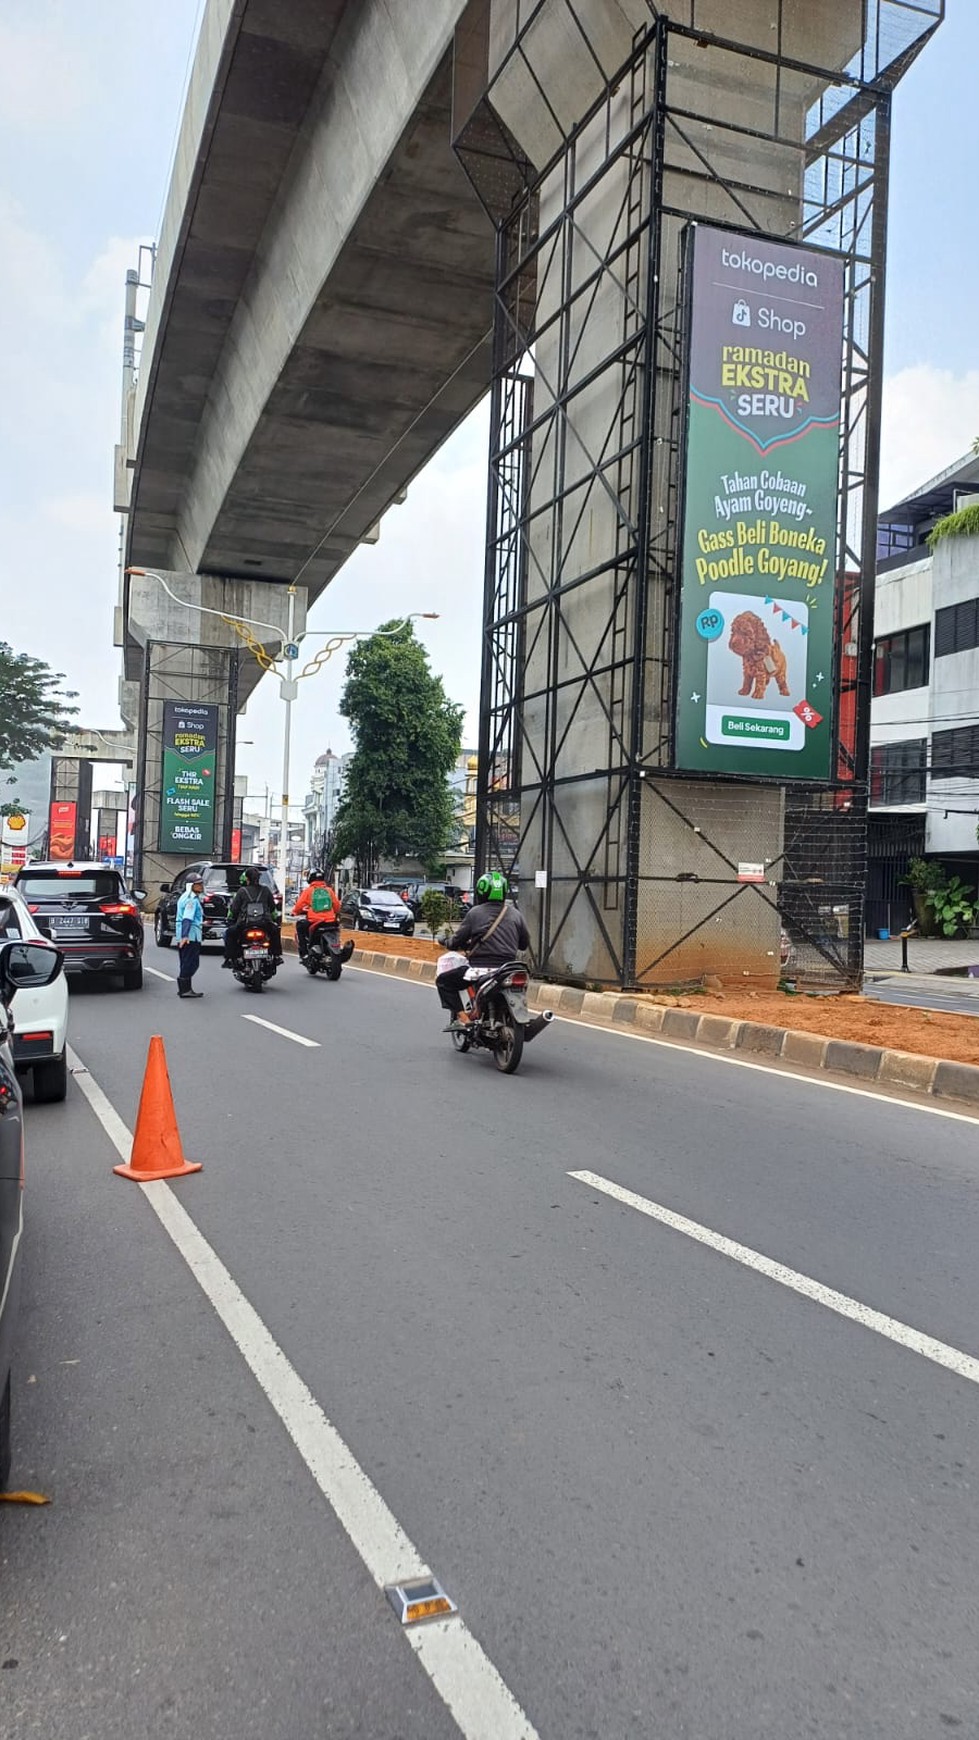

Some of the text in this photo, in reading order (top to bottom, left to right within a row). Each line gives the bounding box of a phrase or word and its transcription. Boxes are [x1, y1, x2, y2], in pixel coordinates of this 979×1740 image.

[721, 248, 818, 287] tokopedia
[757, 307, 807, 339] Shop
[722, 345, 811, 377] ramadan
[721, 363, 810, 402] EKSTRA
[737, 393, 795, 418] SERU
[720, 470, 806, 497] Tahan Cobaan
[714, 495, 752, 521] Ayam
[697, 519, 826, 555] Gass Beli Boneka
[695, 547, 829, 587] Poodle Goyang!
[702, 615, 718, 630] Rp
[186, 721, 204, 730] Shop
[728, 721, 785, 736] Beli Sekarang
[175, 739, 205, 747] EKSTRA
[175, 777, 203, 785] EKSTRA
